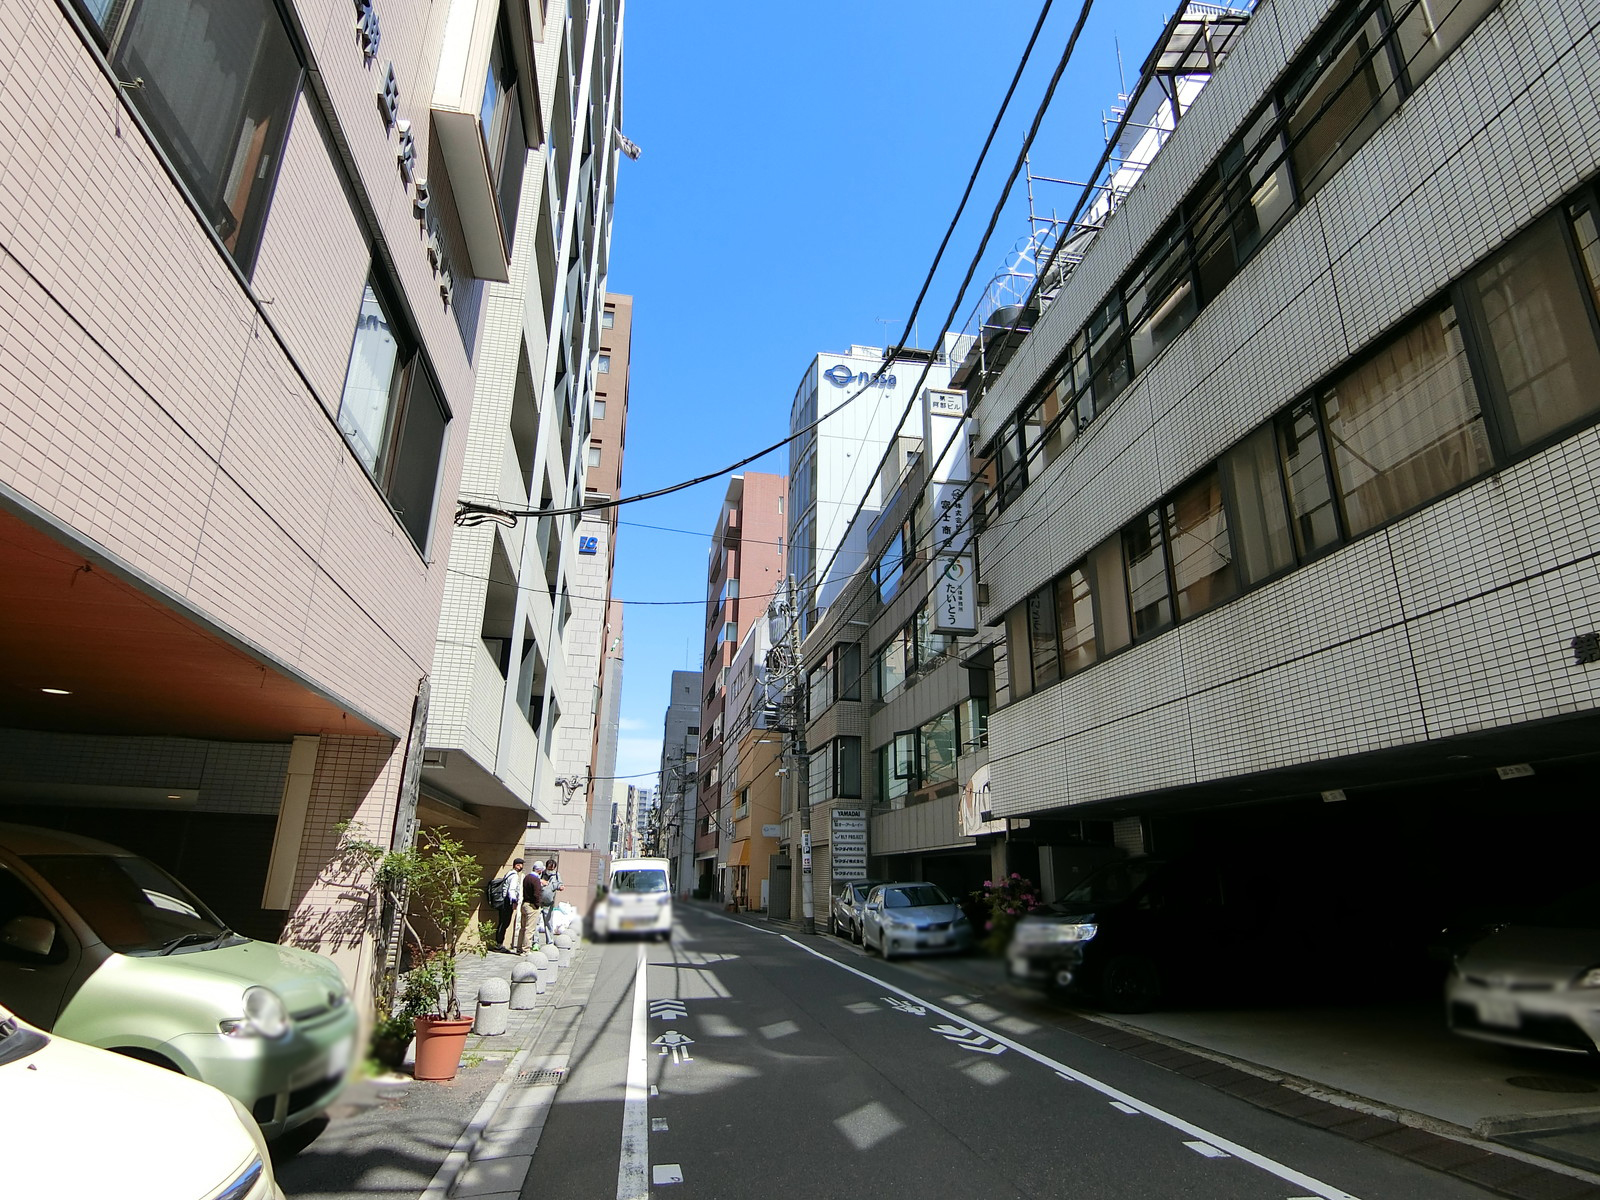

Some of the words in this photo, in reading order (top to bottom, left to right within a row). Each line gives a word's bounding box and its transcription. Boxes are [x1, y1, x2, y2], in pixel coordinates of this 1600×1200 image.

[939, 395, 955, 403] 第二
[932, 401, 961, 410] 阿部ビル
[945, 582, 957, 626] たいとう
